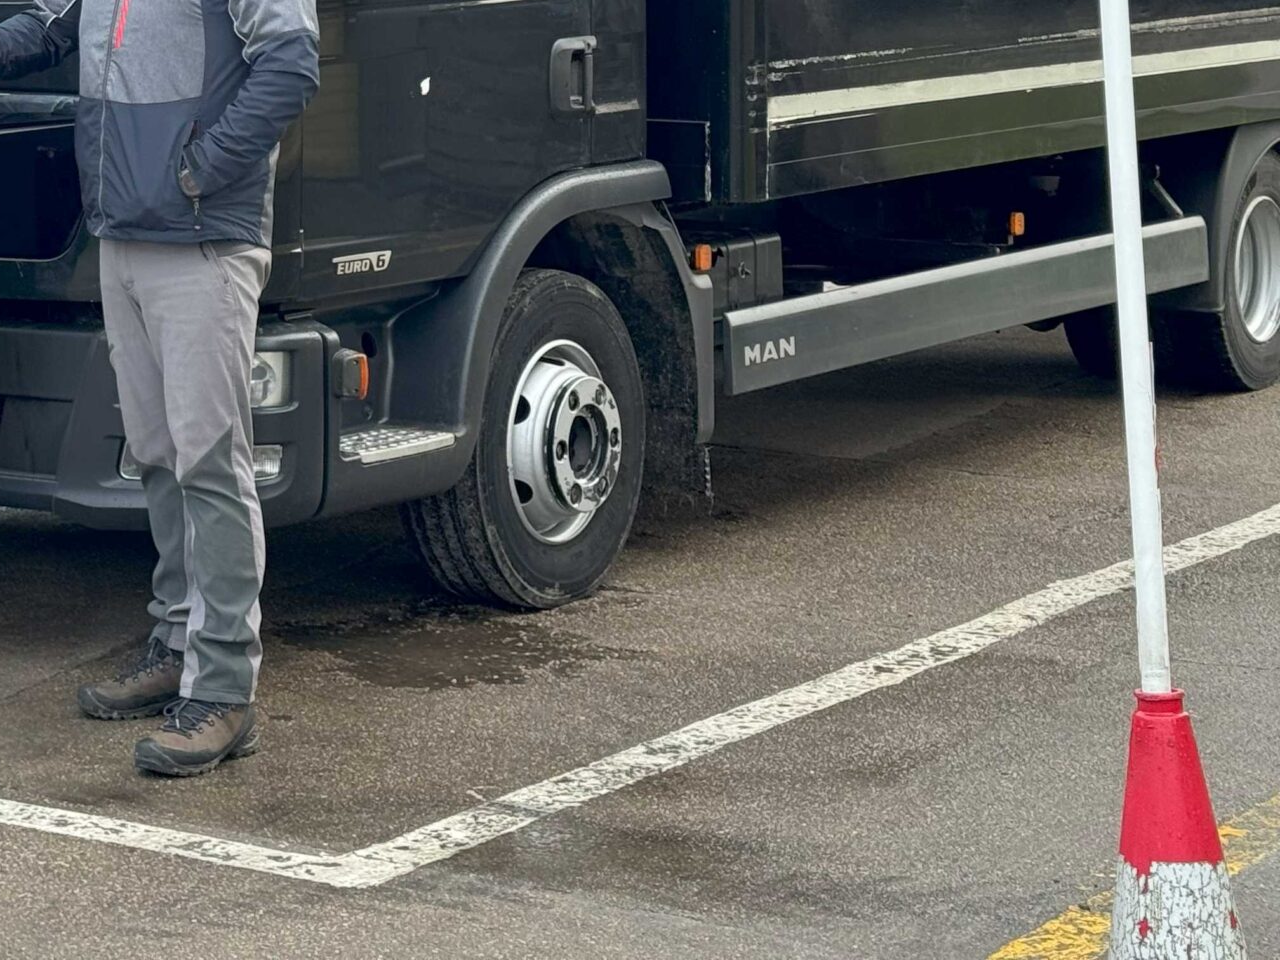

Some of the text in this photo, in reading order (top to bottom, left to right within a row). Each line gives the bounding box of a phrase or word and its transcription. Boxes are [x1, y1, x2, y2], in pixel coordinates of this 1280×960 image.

[337, 254, 386, 275] EURO 6
[744, 336, 795, 367] MAN
